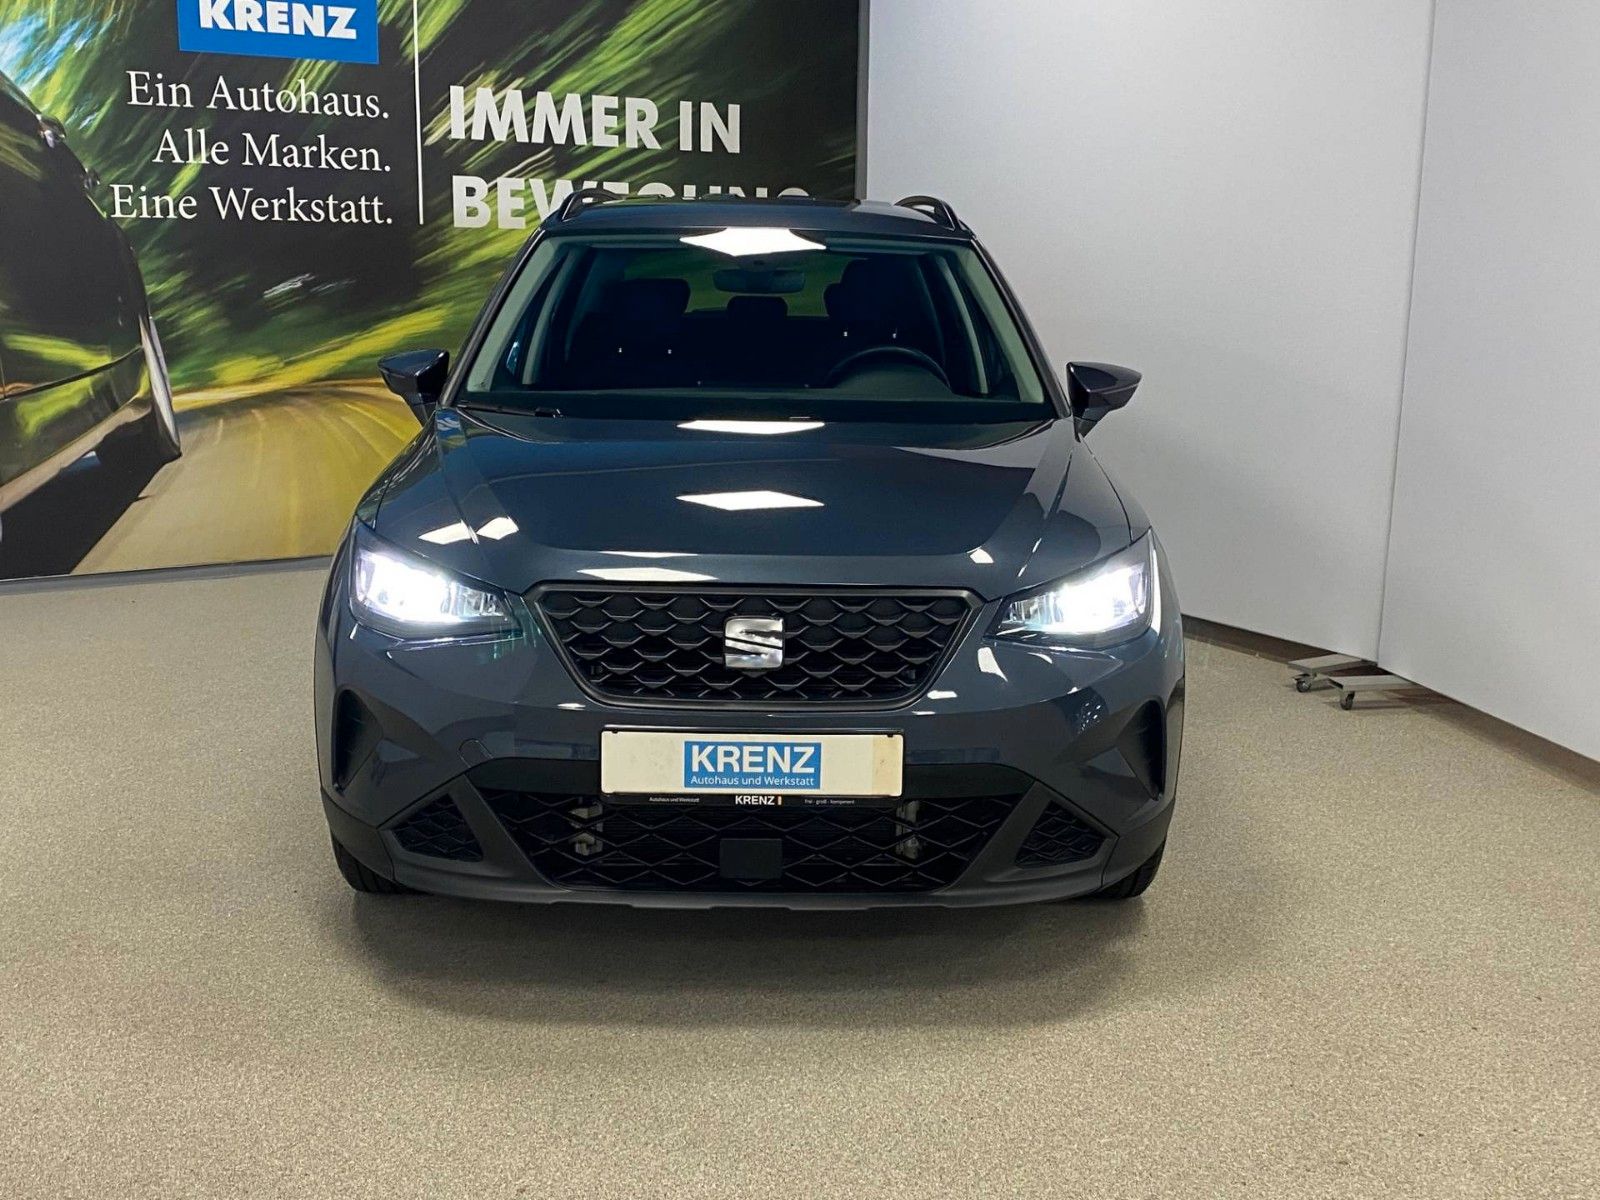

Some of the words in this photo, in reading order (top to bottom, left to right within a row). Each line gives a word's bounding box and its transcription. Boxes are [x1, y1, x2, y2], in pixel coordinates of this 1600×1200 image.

[200, 0, 357, 39] KRENZ
[126, 70, 194, 108] Ein
[206, 75, 389, 119] Autohaus.
[450, 85, 662, 150] IMMER
[679, 101, 741, 154] IN
[152, 128, 229, 165] Alle
[242, 132, 391, 172] Marken.
[110, 184, 198, 219] Eine
[209, 186, 393, 224] Werkstatt.
[692, 745, 815, 773] KRENZ
[690, 775, 739, 785] Autohaus
[742, 775, 761, 785] und
[764, 776, 814, 786] Werkstatt
[735, 795, 775, 806] KRENZ
